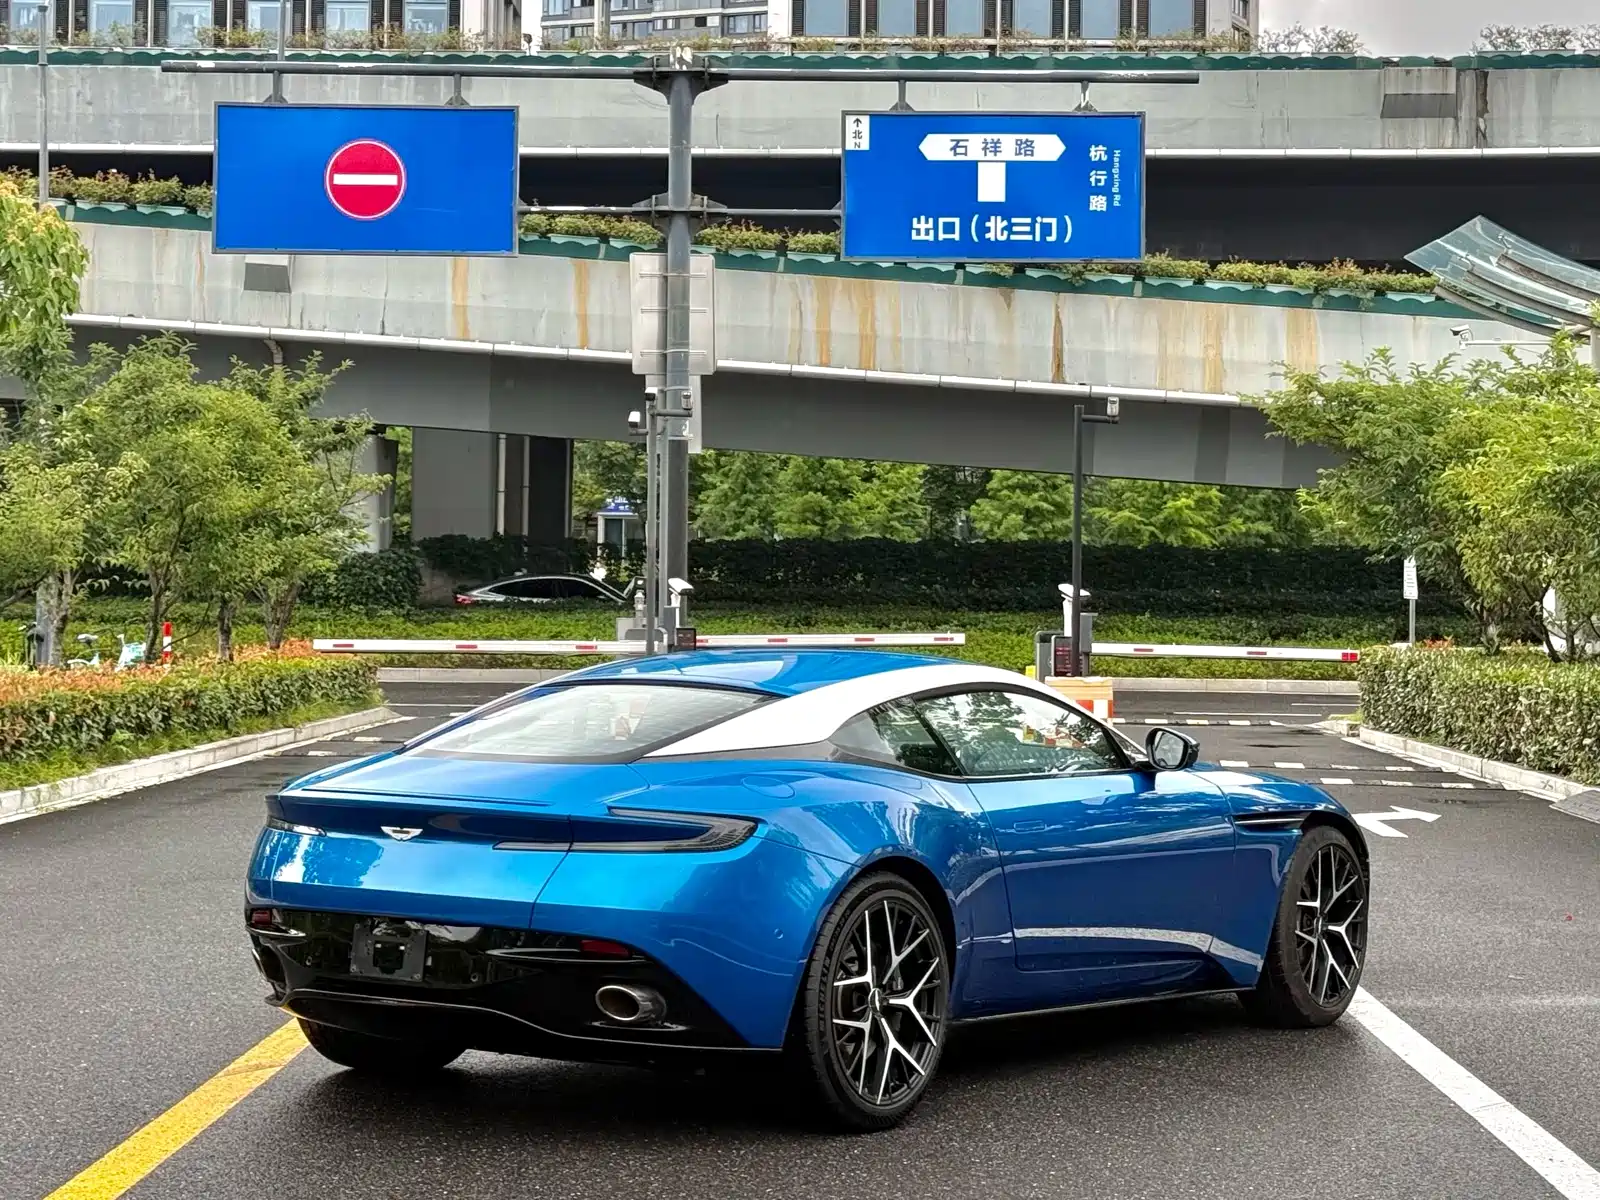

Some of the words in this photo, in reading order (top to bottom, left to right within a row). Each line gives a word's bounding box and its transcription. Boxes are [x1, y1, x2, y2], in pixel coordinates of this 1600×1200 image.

[852, 129, 863, 140] 北
[854, 141, 861, 149] N
[950, 138, 1035, 156] 石祥路
[1090, 145, 1107, 211] 杭行路
[1112, 149, 1121, 193] Hangxing
[1113, 194, 1121, 207] Rd
[819, 956, 831, 1032] MICHELIN
